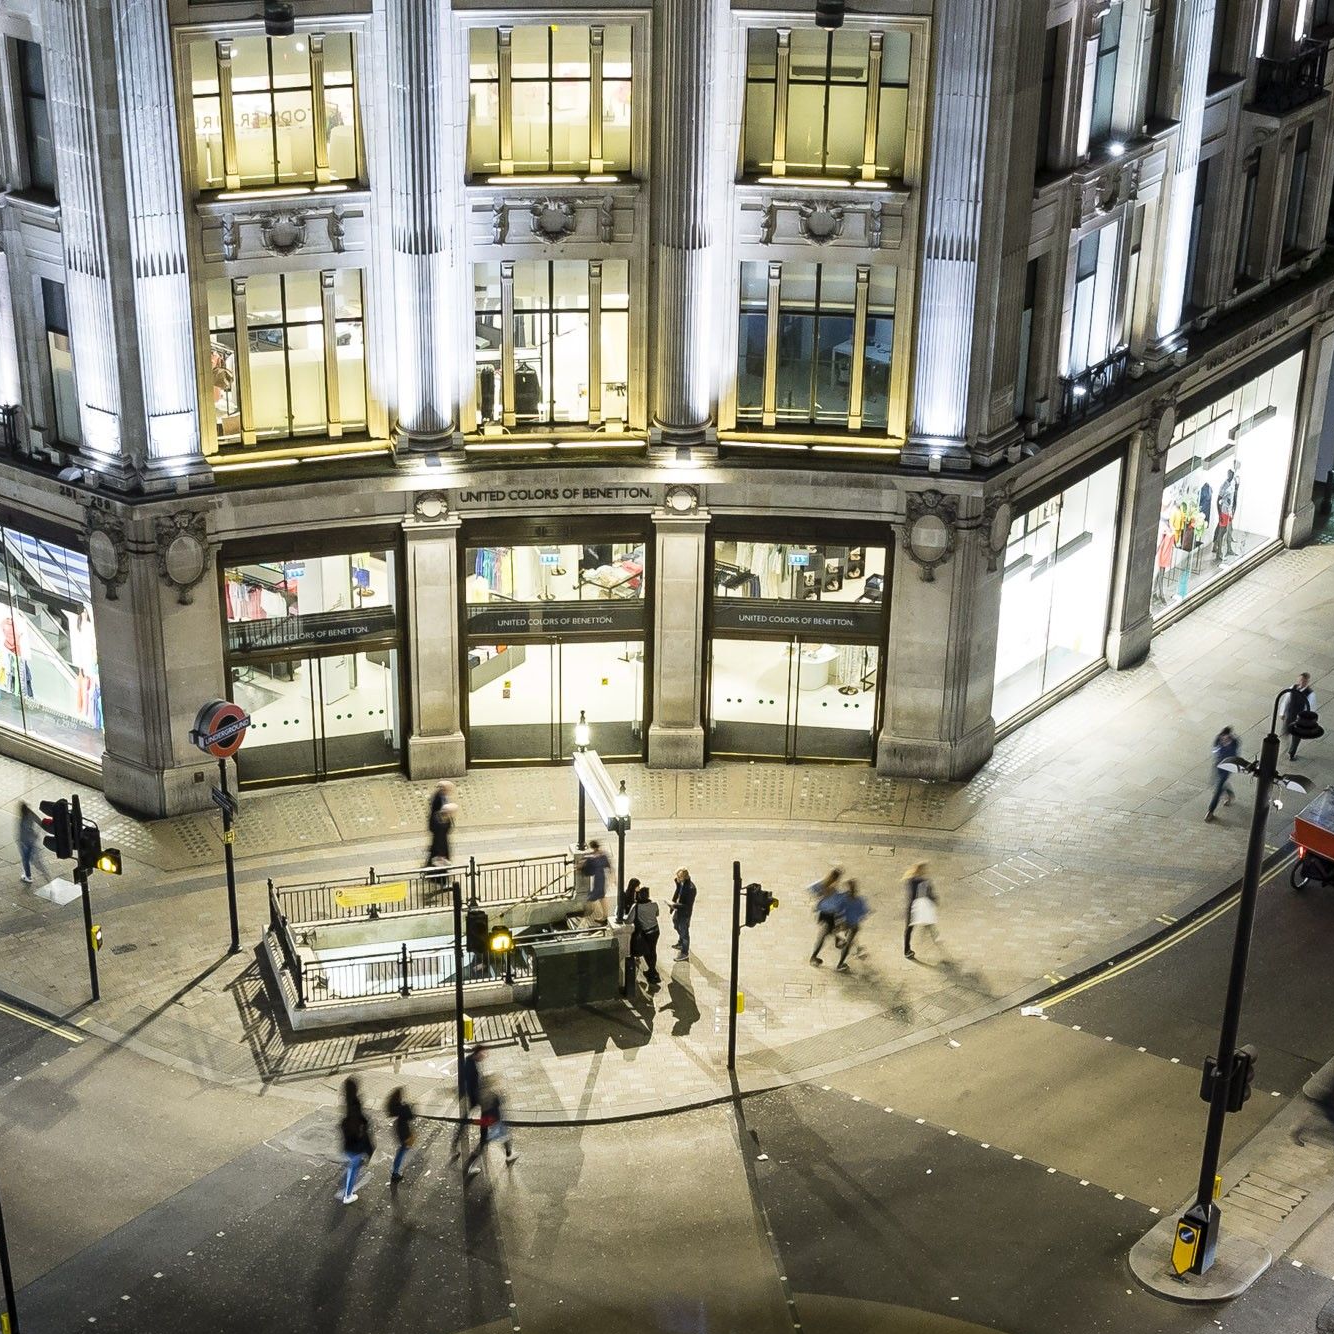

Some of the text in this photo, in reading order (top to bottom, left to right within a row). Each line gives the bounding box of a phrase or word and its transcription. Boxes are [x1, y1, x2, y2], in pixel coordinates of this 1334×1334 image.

[460, 490, 506, 503] UNITED
[507, 488, 559, 501] COLORS
[562, 487, 581, 500] OF
[497, 616, 527, 627] UNITED
[527, 617, 560, 627] COLORS
[560, 617, 572, 626] OF
[738, 614, 768, 624] UNITED
[768, 615, 800, 625] COLORS
[801, 617, 813, 625] OF
[283, 630, 316, 643] COLORS
[316, 629, 328, 639] OF
[205, 719, 250, 745] UNDERGROUND
